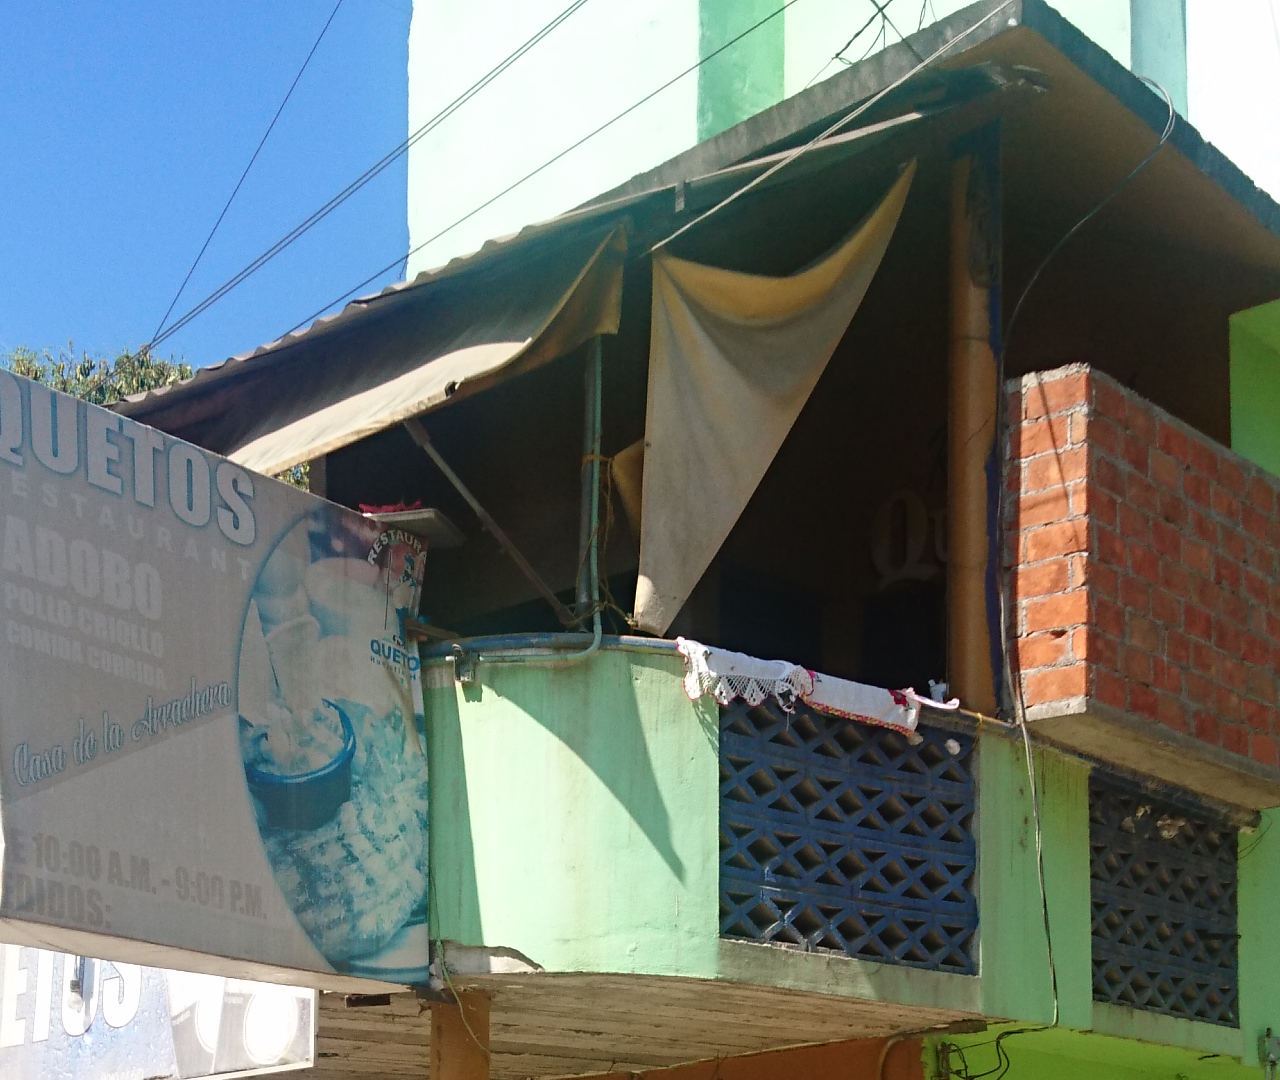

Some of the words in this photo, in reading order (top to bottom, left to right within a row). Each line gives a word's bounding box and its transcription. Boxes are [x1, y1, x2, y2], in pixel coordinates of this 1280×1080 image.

[1, 514, 163, 621] ADOBO
[3, 580, 71, 629] POLLO
[77, 605, 165, 659] CRIOLLO
[6, 619, 84, 665] COMIDA
[86, 645, 167, 691] CORRIDA
[13, 743, 67, 787] Casa
[72, 718, 98, 765] de
[103, 710, 125, 754] la
[131, 676, 233, 743] Arrachera
[31, 832, 103, 883] 10:00
[107, 850, 158, 896] A.M.
[174, 866, 225, 910] 9:00
[228, 879, 268, 920] P.M.
